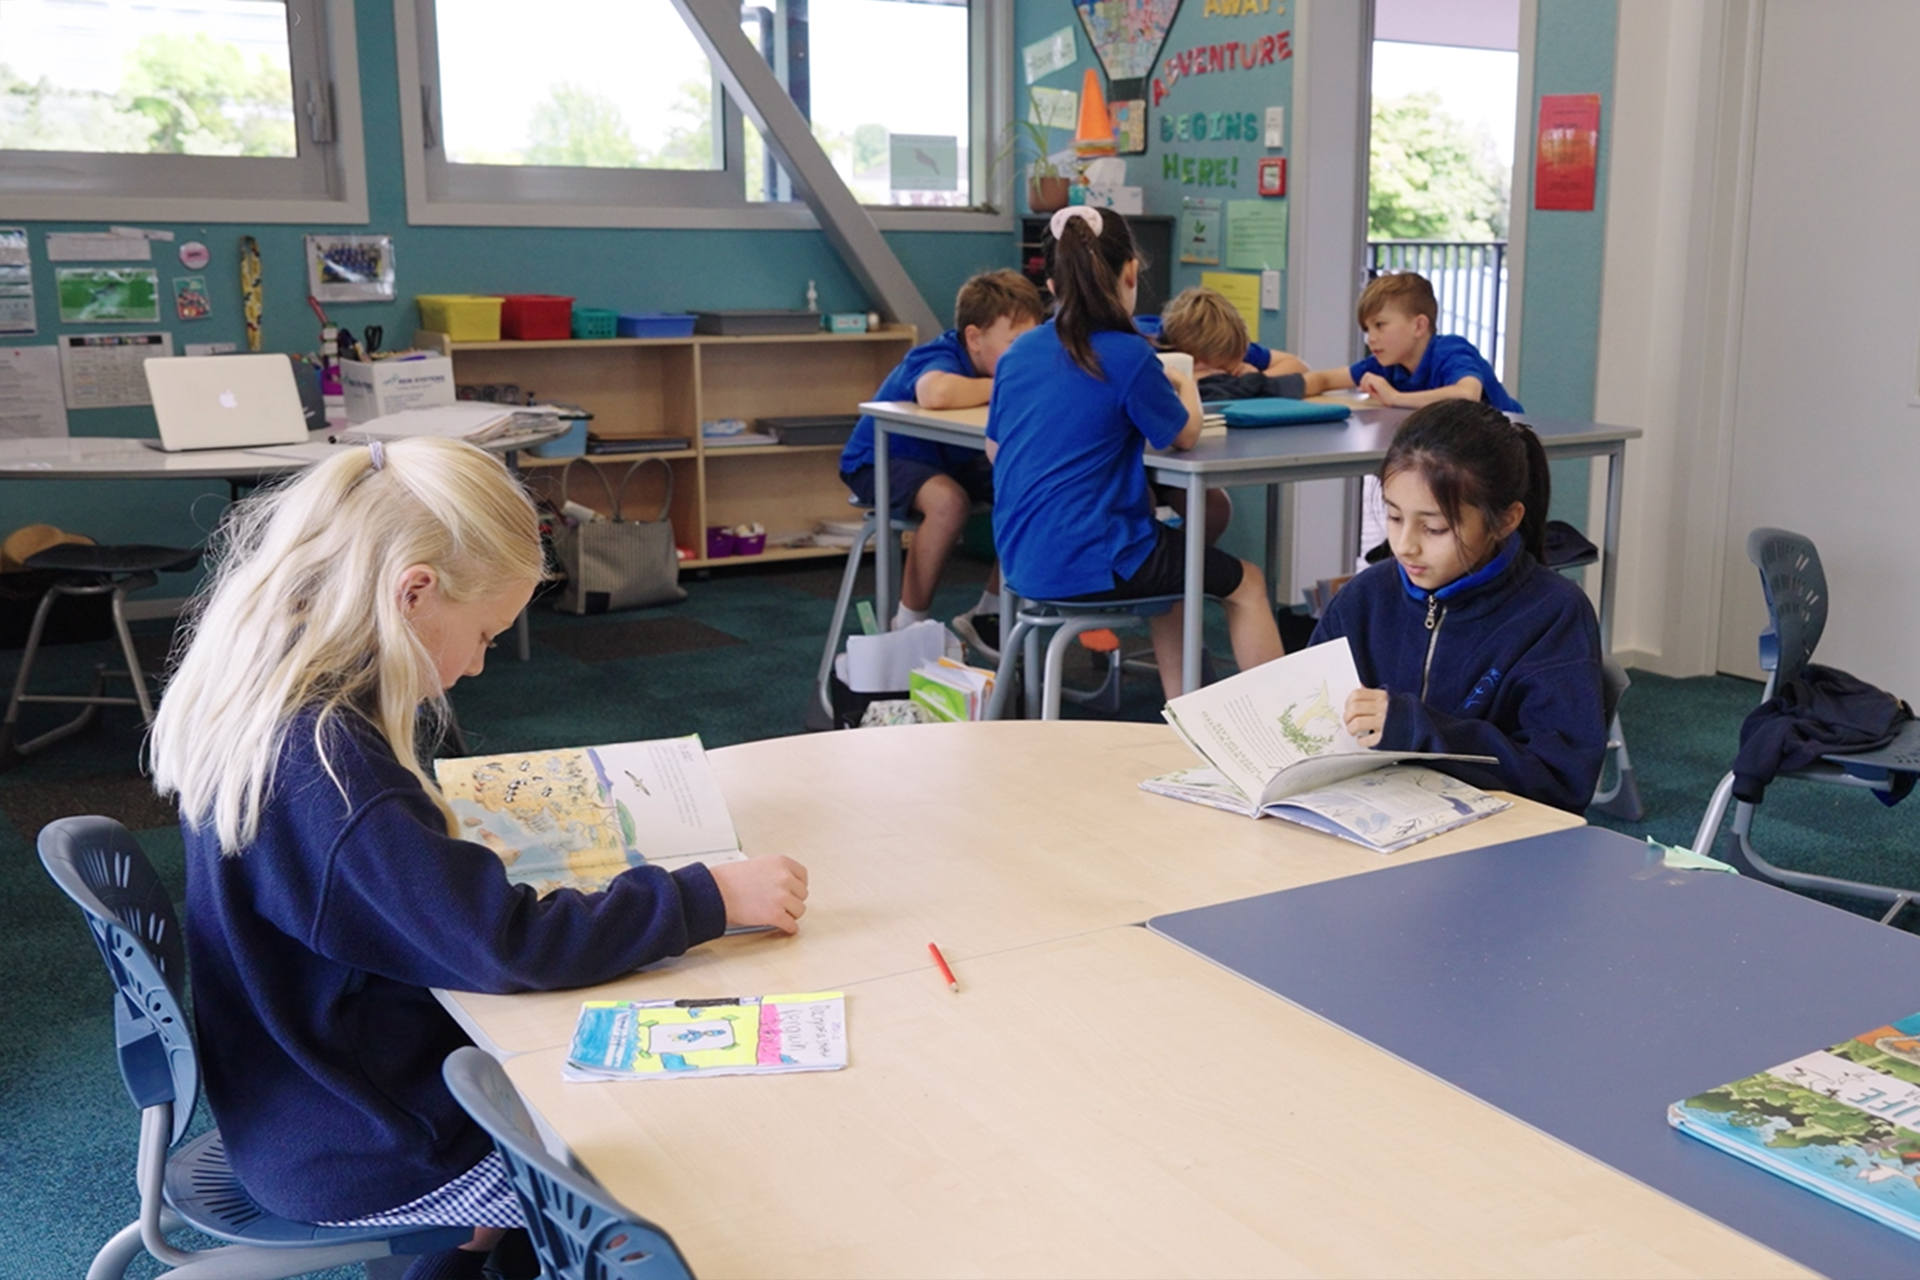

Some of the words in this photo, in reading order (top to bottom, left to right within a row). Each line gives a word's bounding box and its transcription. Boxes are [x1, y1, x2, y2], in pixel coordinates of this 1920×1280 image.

[1202, 0, 1286, 18] AWA
[1151, 30, 1293, 106] ADVENTURE
[1160, 110, 1258, 142] BEGINS
[1163, 152, 1238, 188] HERE!
